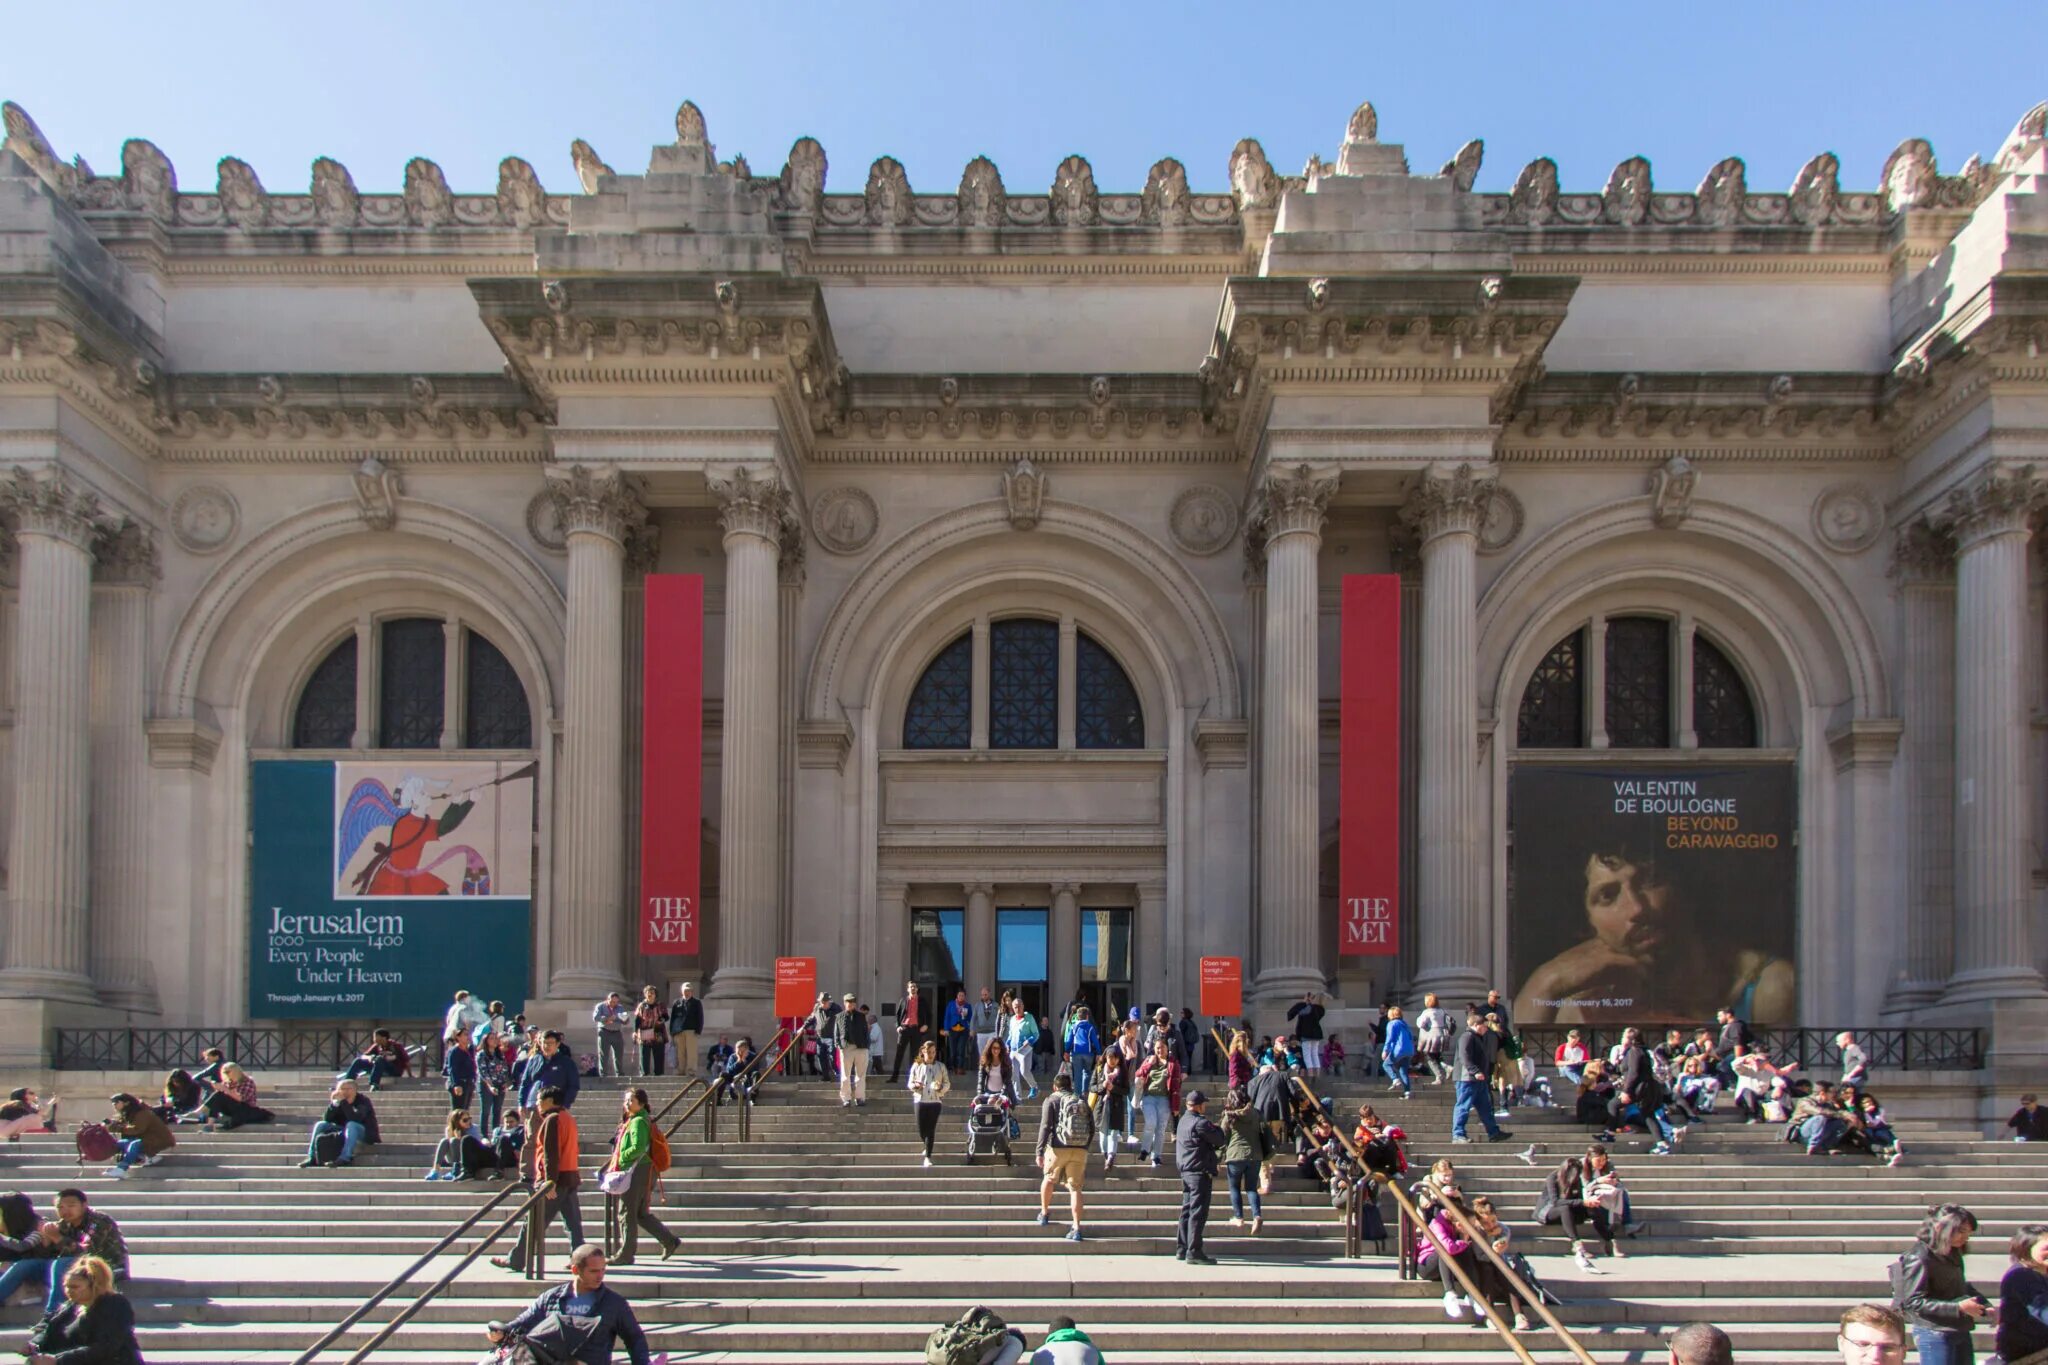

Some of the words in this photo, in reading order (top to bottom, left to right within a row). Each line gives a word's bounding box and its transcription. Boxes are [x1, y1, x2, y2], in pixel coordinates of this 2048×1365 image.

[1613, 781, 1696, 796] VALENTIN
[1614, 798, 1637, 813] DE
[1642, 798, 1736, 814] BOULOGNE
[1667, 816, 1739, 831] BEYOND
[1666, 833, 1779, 849] CARAVAGGIO
[649, 897, 691, 919] THE
[1347, 897, 1390, 920] THE
[268, 907, 404, 935] Jerusalem
[648, 920, 692, 942] MET
[1346, 921, 1391, 943] MET
[269, 935, 305, 946] 1000
[367, 935, 404, 950] 1400
[268, 948, 311, 966] Every
[315, 947, 365, 967] People
[297, 968, 343, 984] Under
[347, 968, 402, 984] Heaven
[267, 993, 302, 1003] Through
[303, 993, 335, 1003] January
[345, 993, 365, 1002] 2017
[1532, 998, 1565, 1008] Through
[1567, 998, 1600, 1008] January
[1613, 998, 1633, 1006] 2017
